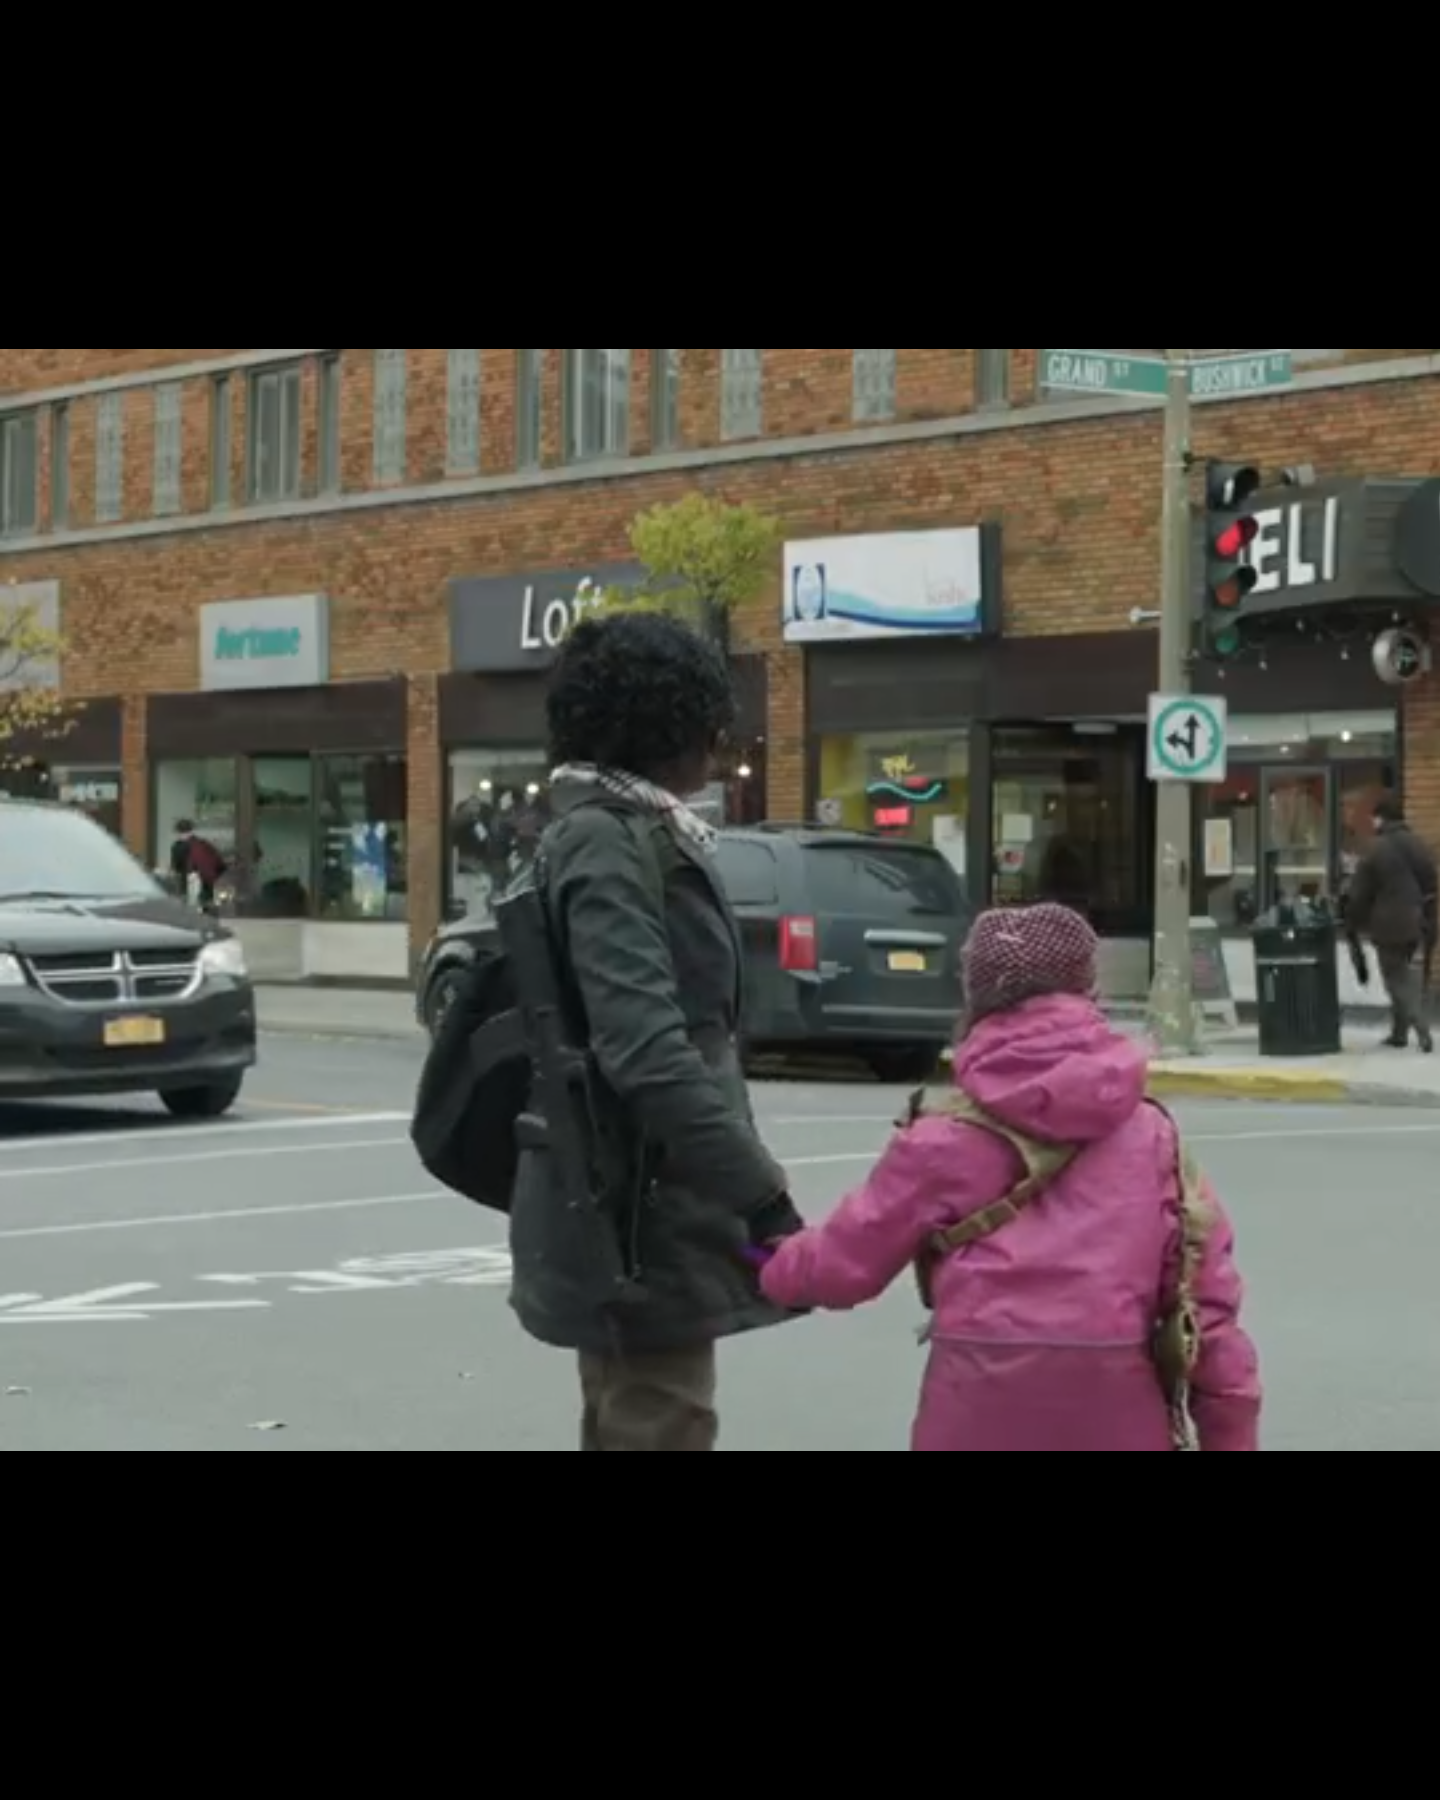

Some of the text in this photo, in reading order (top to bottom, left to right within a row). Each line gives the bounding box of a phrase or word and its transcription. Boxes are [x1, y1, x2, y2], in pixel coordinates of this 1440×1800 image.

[1048, 354, 1130, 386] GRAND ST
[1191, 356, 1285, 394] BUSHWICK ST
[1237, 497, 1337, 593] ELI
